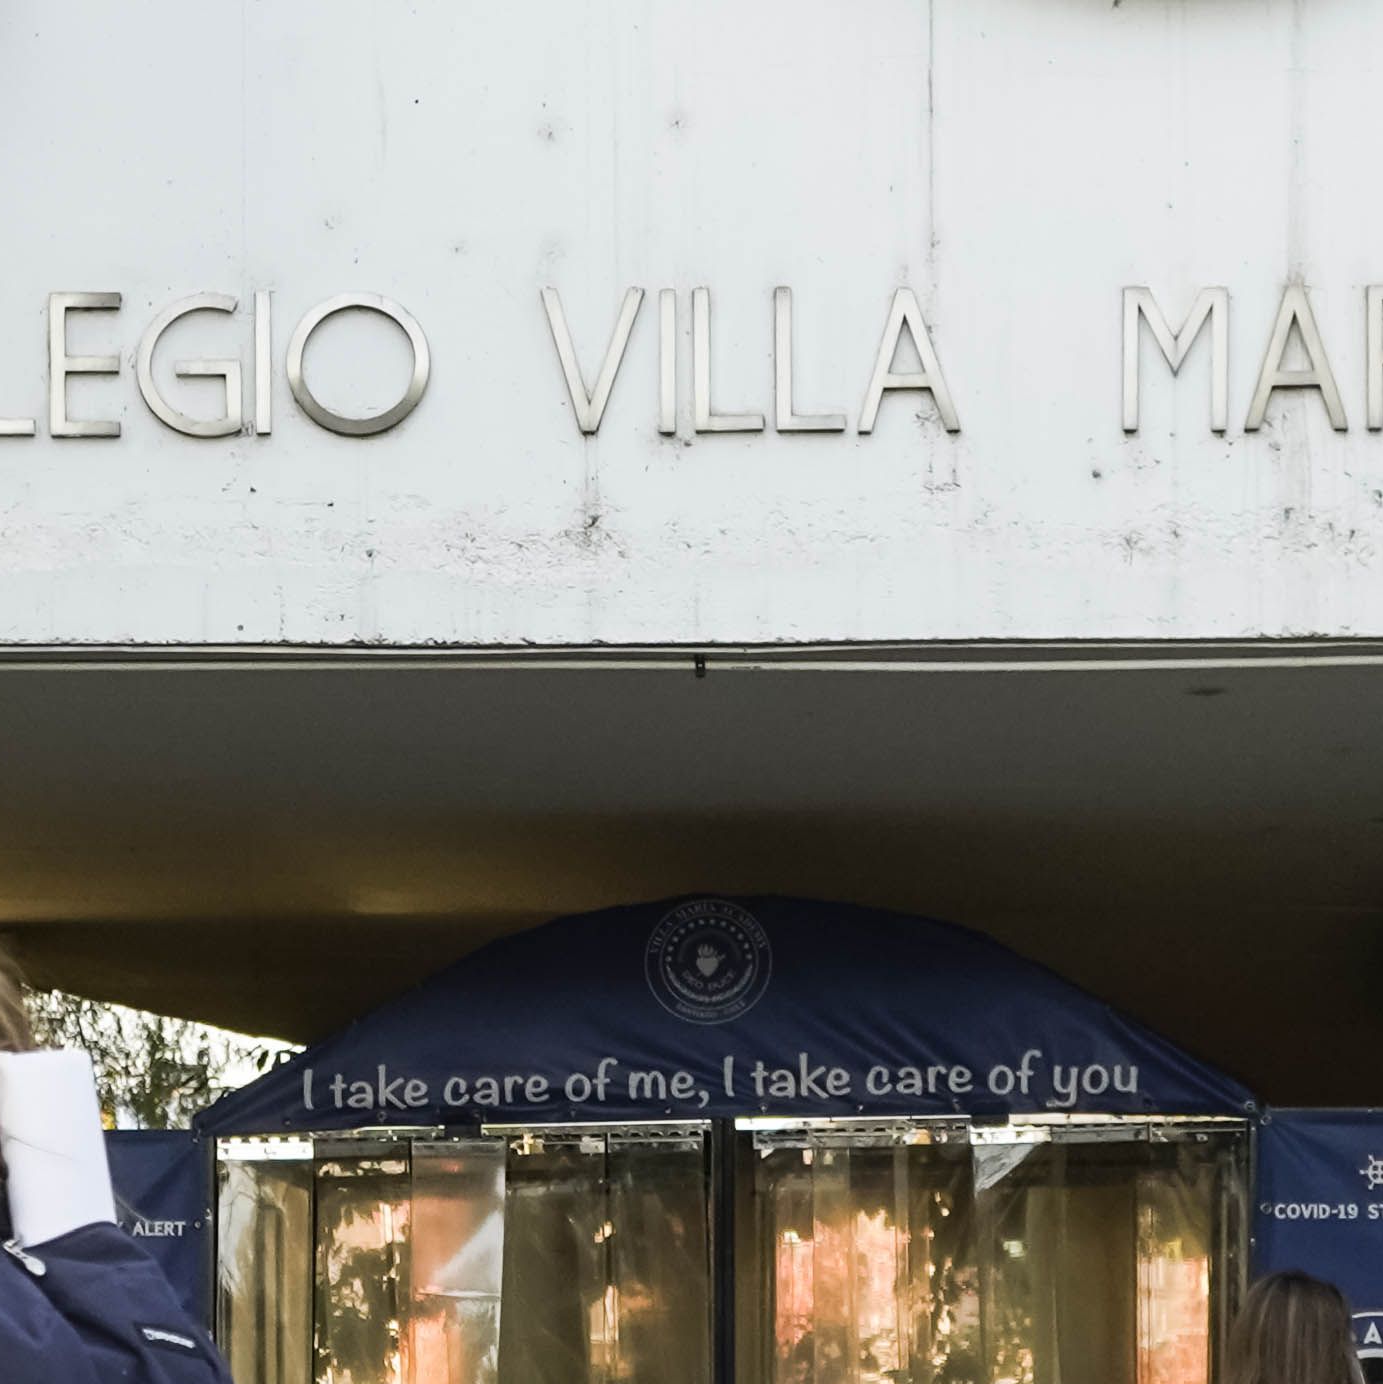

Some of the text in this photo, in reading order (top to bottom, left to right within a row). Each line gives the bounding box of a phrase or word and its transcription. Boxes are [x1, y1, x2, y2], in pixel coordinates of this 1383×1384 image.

[540, 286, 962, 436] VILLA
[303, 1049, 1139, 1110] I take care of me, I take care of you
[132, 1221, 186, 1237] ALERT
[1274, 1203, 1358, 1219] COVID-19
